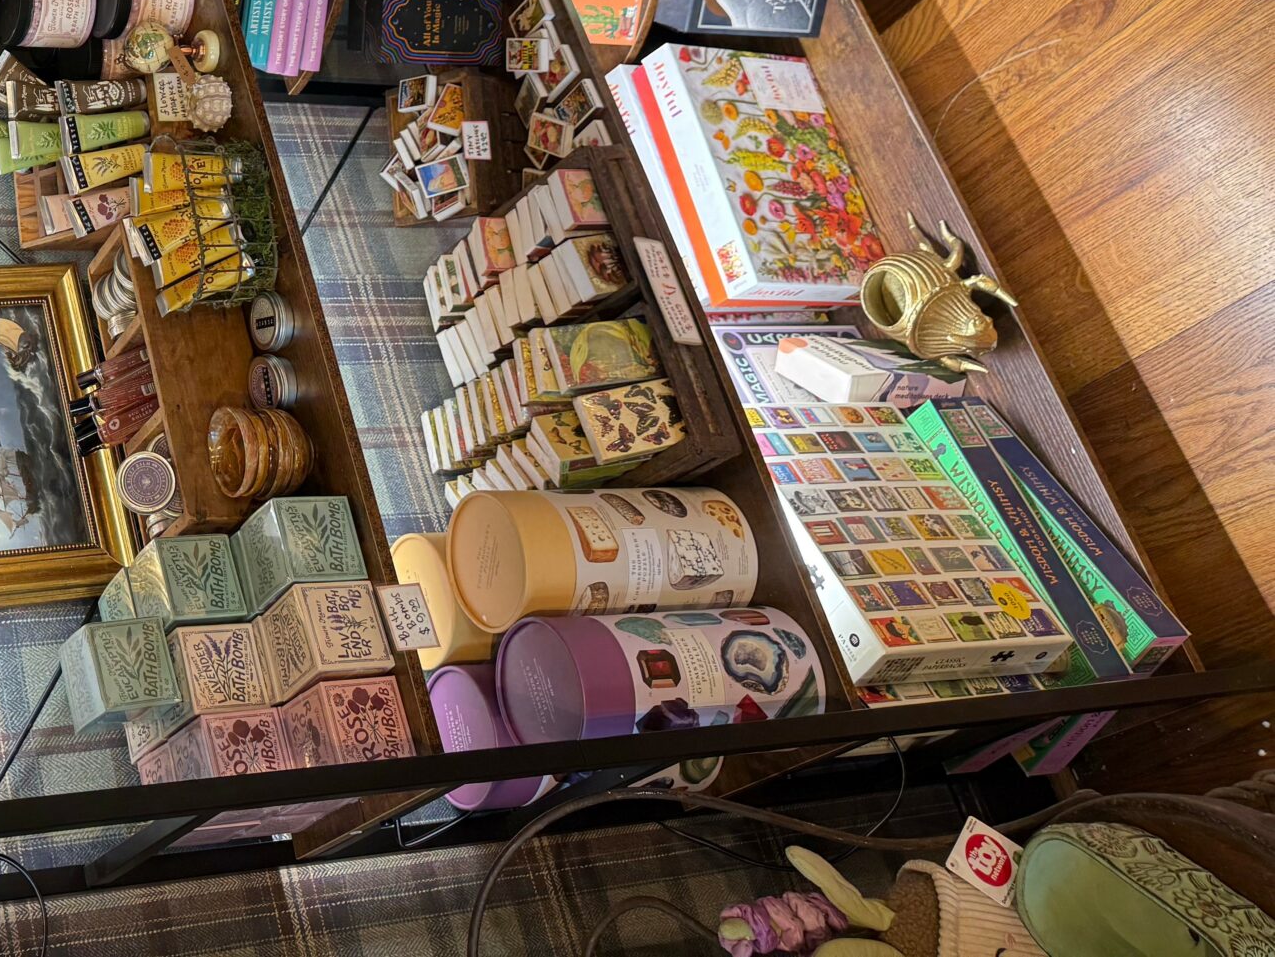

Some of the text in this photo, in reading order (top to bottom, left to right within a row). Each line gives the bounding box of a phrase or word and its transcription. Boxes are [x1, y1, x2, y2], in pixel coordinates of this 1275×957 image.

[279, 8, 287, 28] STORY
[293, 12, 302, 32] STORY
[297, 2, 304, 10] OF
[432, 3, 442, 34] Magic
[423, 0, 432, 47] All of You
[291, 33, 299, 54] SHORT
[175, 76, 187, 118] HAND CREAM
[66, 117, 79, 150] TESTER
[473, 124, 481, 157] MATCHES
[141, 225, 159, 257] TESTER
[809, 337, 872, 371] meditations
[810, 345, 848, 365] nature
[735, 357, 771, 404] MAGIC
[1018, 464, 1104, 556] WISDOM & WHIMSY
[284, 506, 325, 573] EUCALYPTUS
[988, 478, 1059, 586] WISDOM & WHIMSY
[1017, 506, 1049, 552] BOOKSHOP
[168, 545, 206, 610] EUCALYPTUS
[209, 540, 225, 608] BATH BOMB
[640, 551, 648, 583] PUZZLE
[326, 590, 339, 613] BATH
[339, 596, 350, 612] BO
[349, 589, 362, 608] MB
[1003, 592, 1018, 610] 1000
[142, 623, 158, 697] BATH BOMB
[338, 633, 350, 658] LAV
[350, 631, 362, 658] END
[362, 639, 372, 657] ER
[99, 631, 139, 700] EUCALYPTUS
[193, 642, 226, 704] LAVENDER
[231, 631, 246, 702] BATH BOMB
[679, 636, 703, 695] GEMSTONES
[691, 644, 708, 683] PUZZLE
[259, 720, 275, 759] BOMB
[967, 834, 1001, 874] toy
[990, 851, 1007, 881] network
